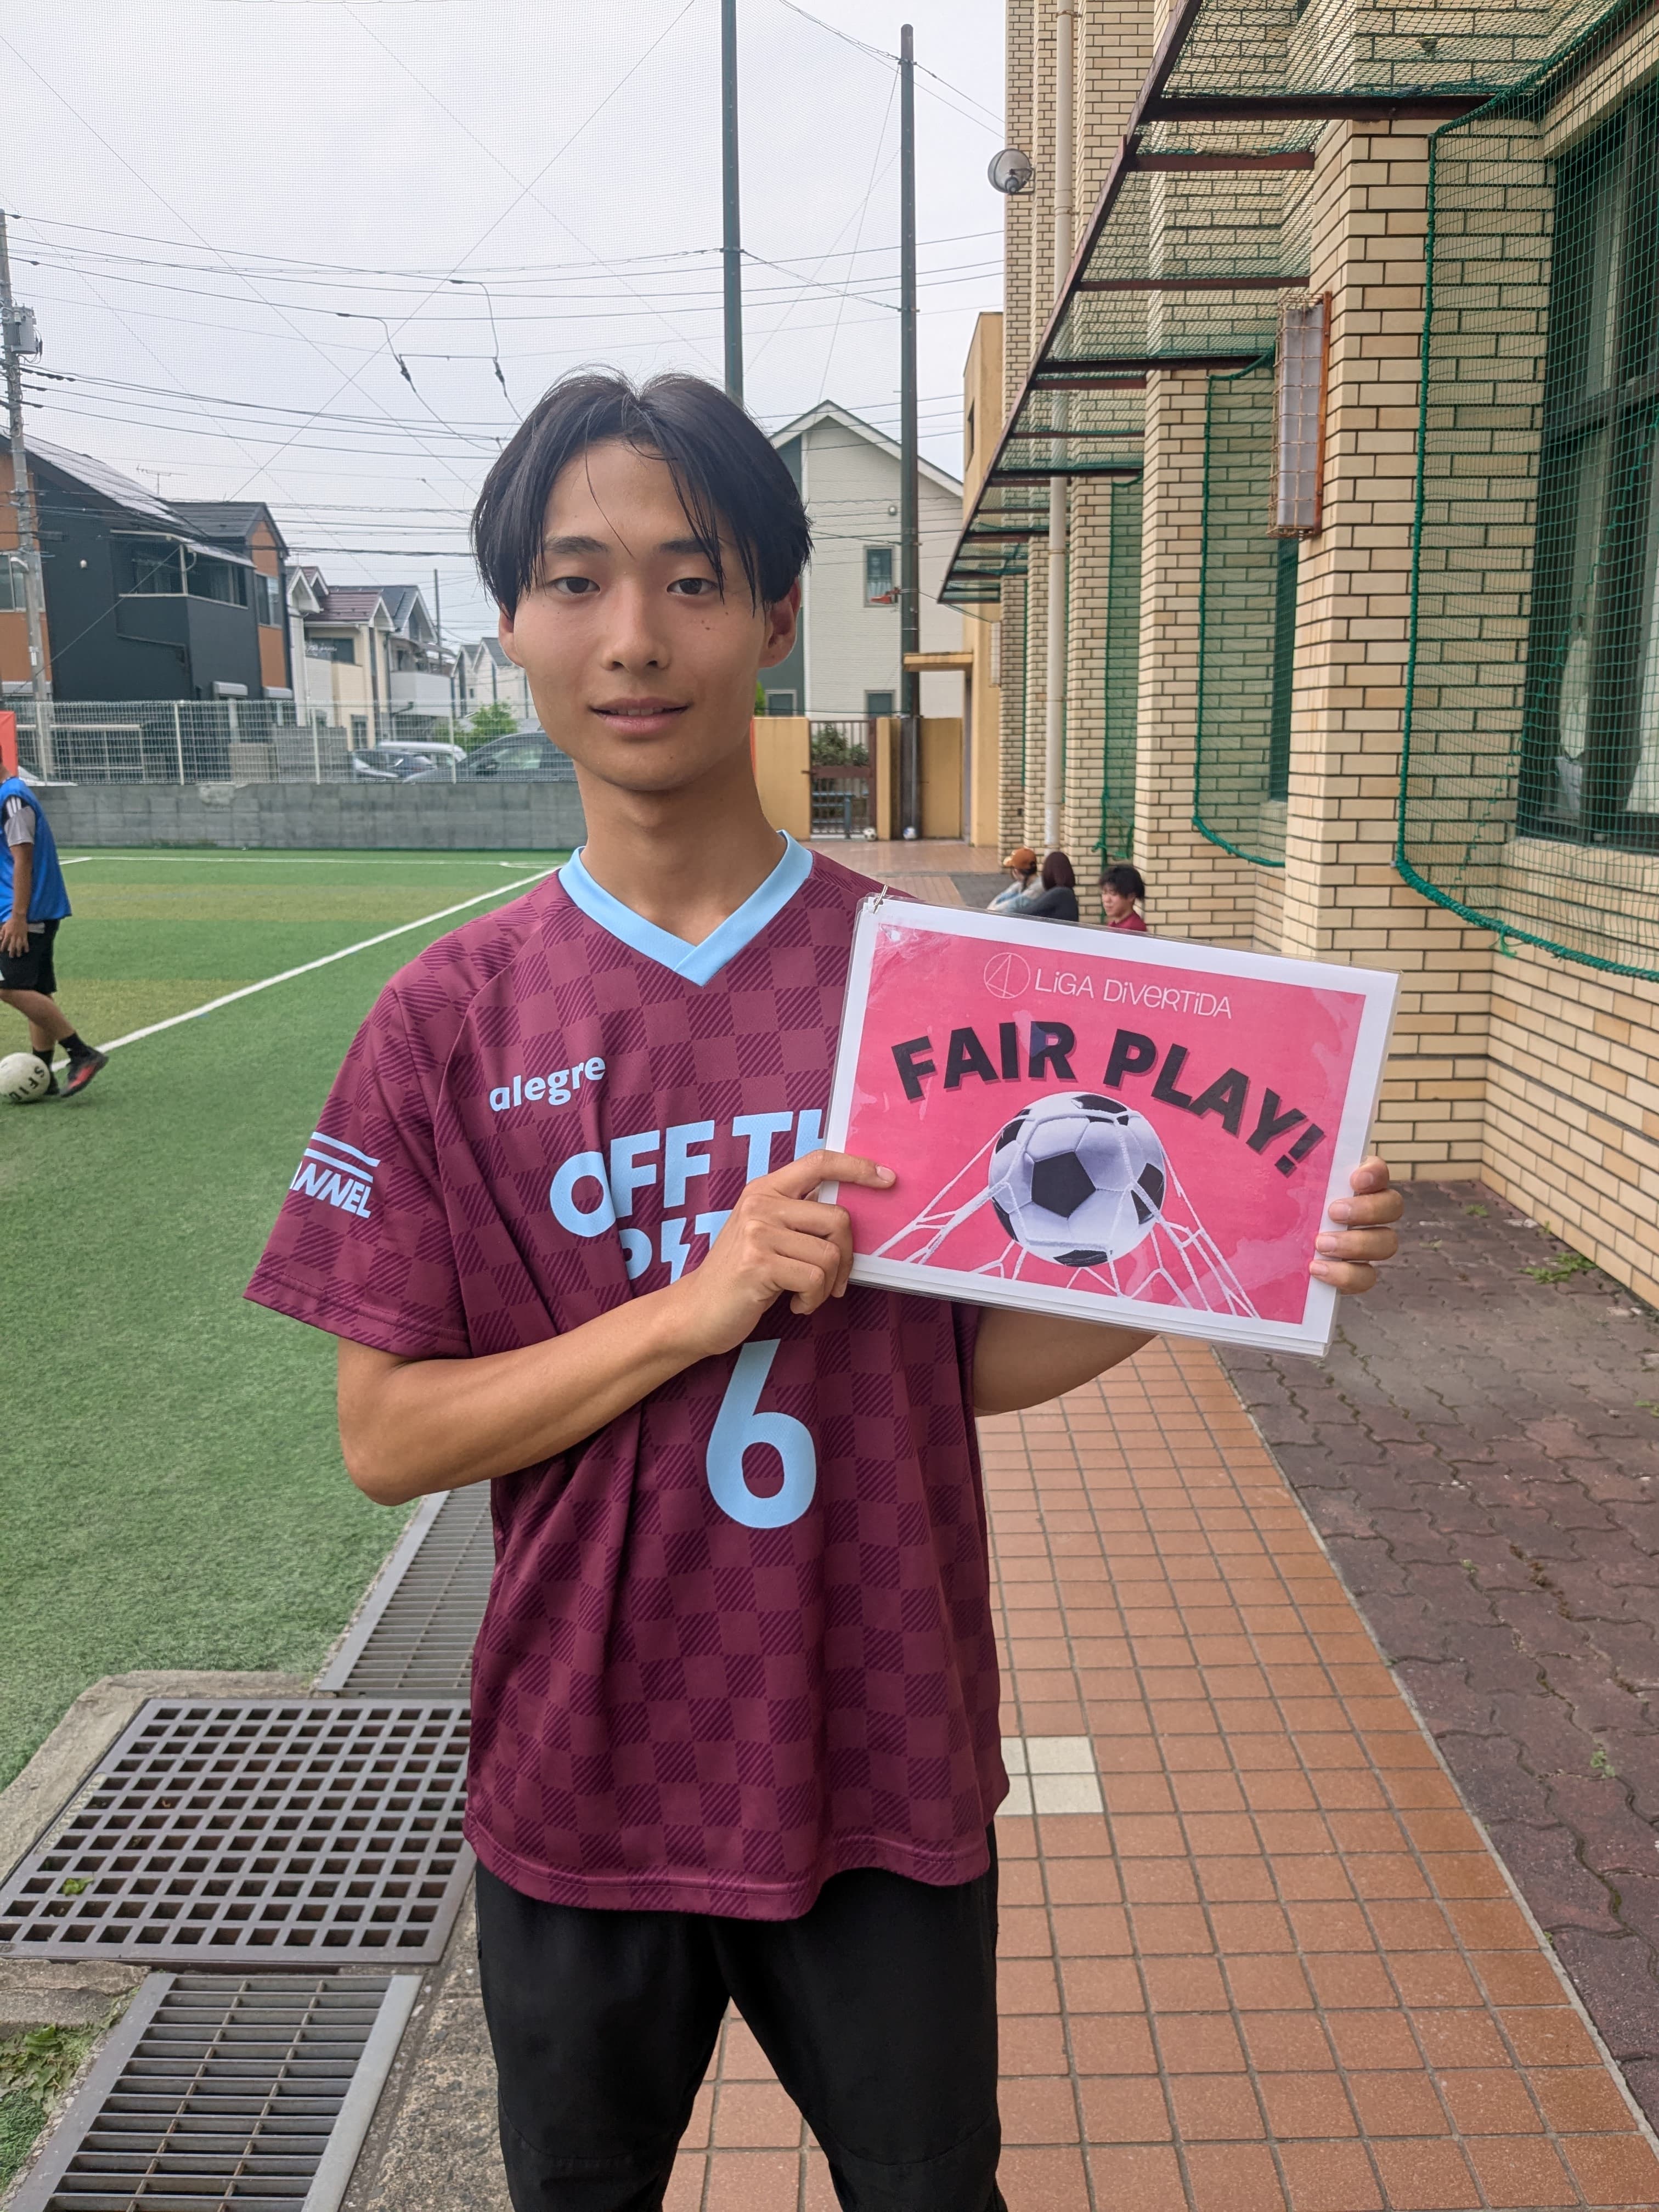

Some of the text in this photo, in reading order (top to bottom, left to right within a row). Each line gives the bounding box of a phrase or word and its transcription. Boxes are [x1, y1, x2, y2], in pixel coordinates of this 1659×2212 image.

[489, 1057, 606, 1112] alegre
[890, 1020, 1326, 1178] FAIR PLAY!
[289, 1160, 371, 1218] NNEL
[550, 1120, 715, 1238] OFF
[706, 1339, 816, 1529] 6
